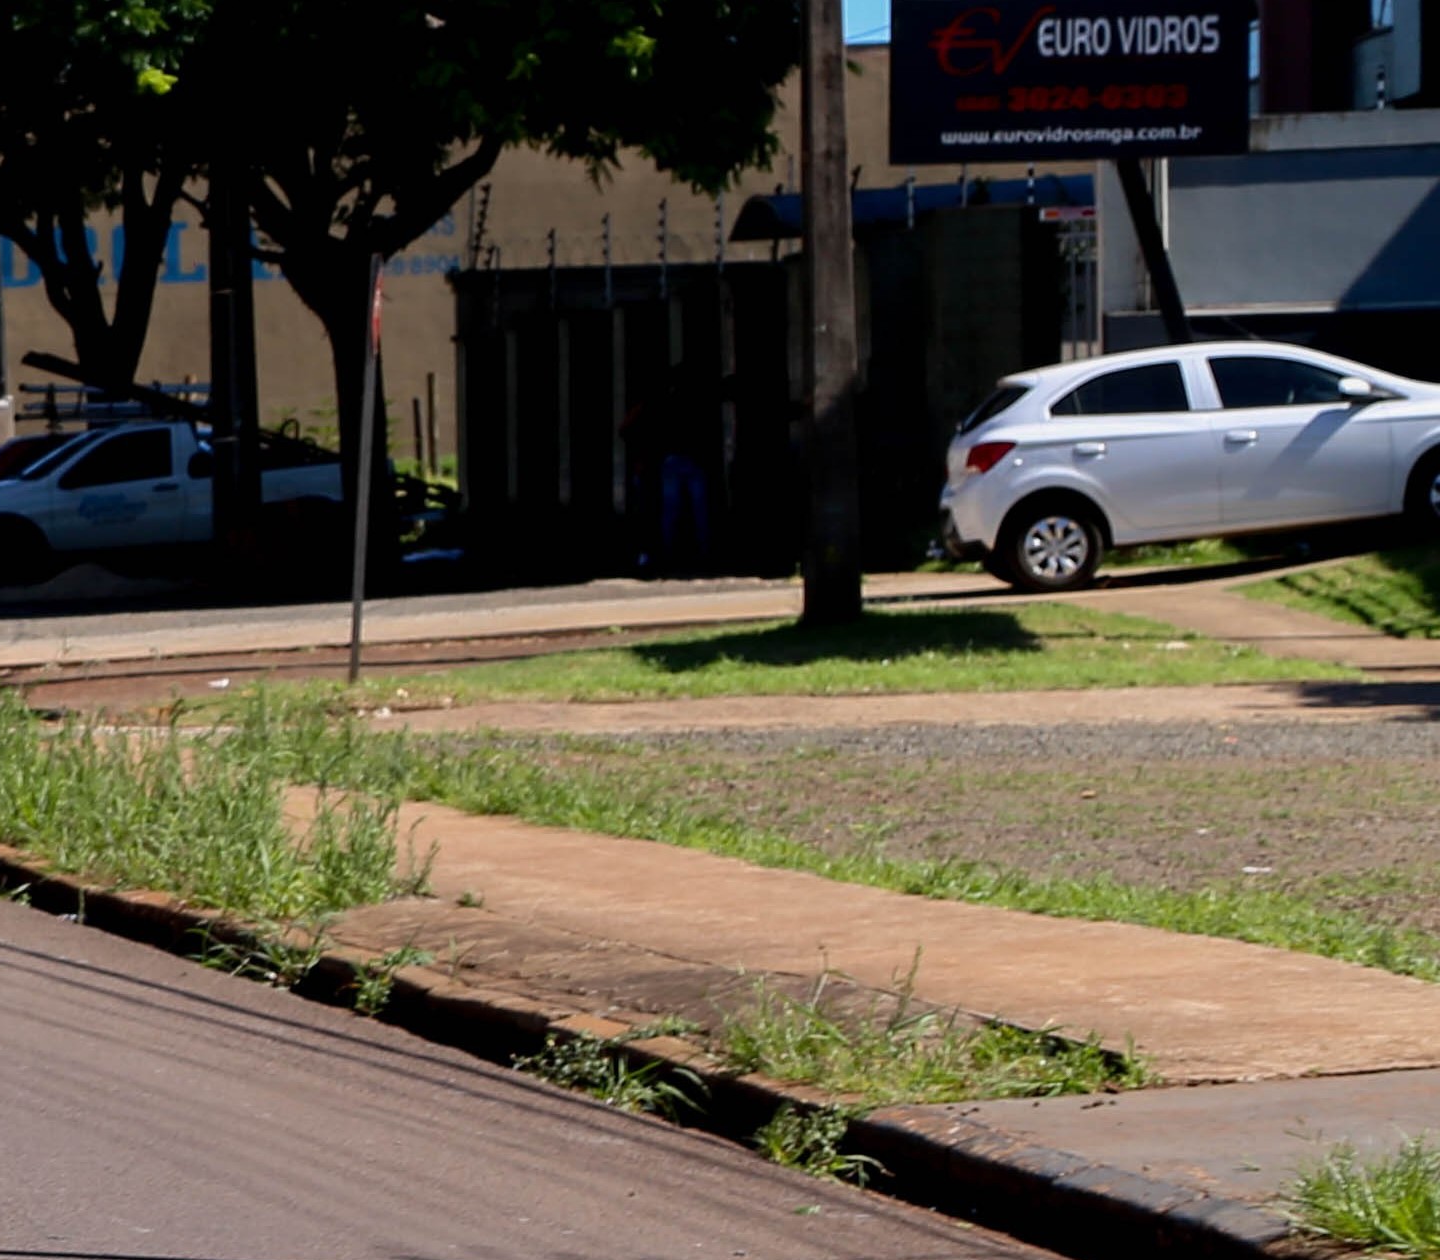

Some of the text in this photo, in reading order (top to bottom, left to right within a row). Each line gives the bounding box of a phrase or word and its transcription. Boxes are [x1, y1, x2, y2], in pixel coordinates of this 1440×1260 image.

[1037, 14, 1220, 57] EURO VIDROS
[940, 124, 1203, 146] www.eurovidrosmga.com.br
